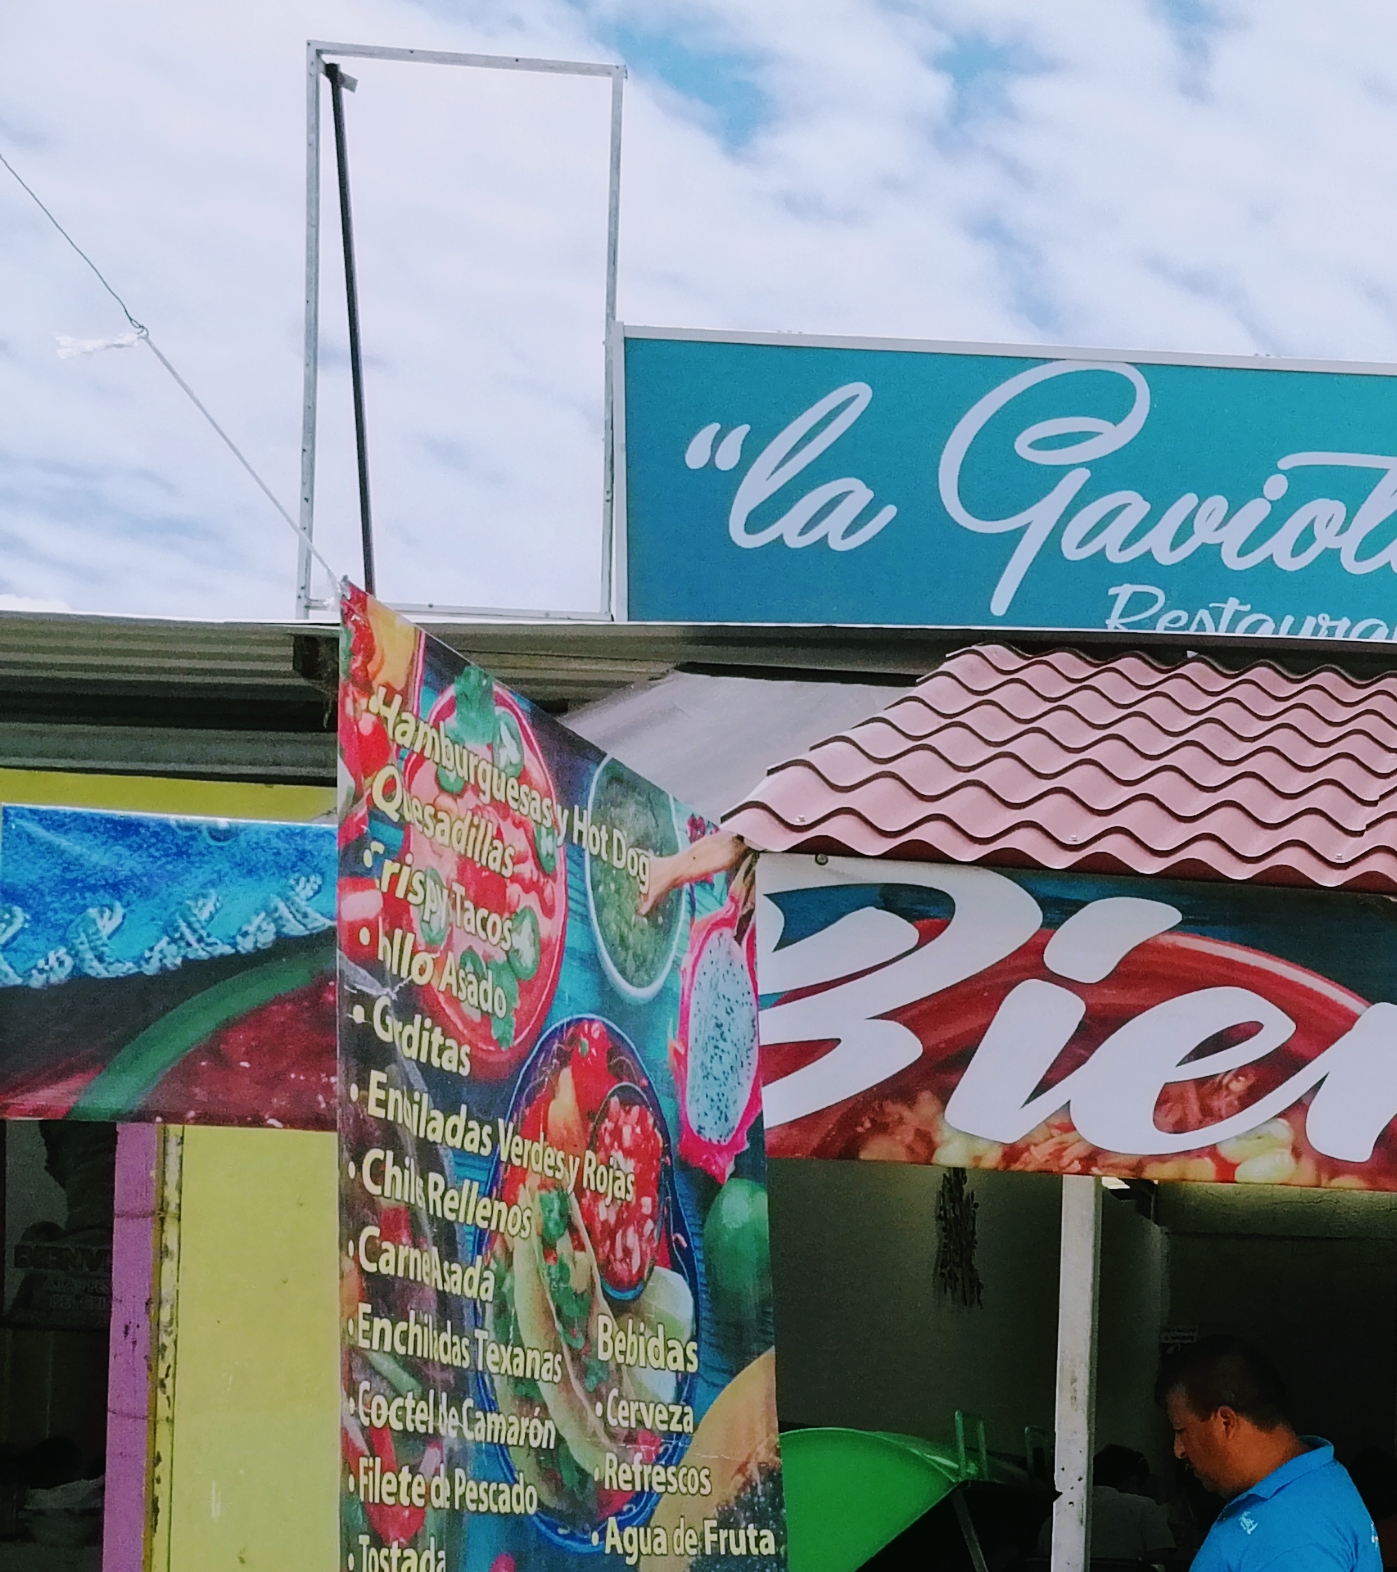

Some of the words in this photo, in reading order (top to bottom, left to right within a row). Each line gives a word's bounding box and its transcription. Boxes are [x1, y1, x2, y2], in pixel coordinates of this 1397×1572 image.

[377, 686, 552, 828] Hamburguesas
[557, 806, 569, 845] y
[573, 805, 607, 855] Hot
[613, 830, 650, 892] Dog
[451, 881, 512, 951] Tacos
[439, 950, 507, 1018] Asado
[373, 995, 470, 1077] Grditas
[499, 1119, 565, 1183] Verdes
[566, 1154, 580, 1191] y
[583, 1150, 635, 1206] Rojas
[428, 1172, 533, 1238] Rellenos
[358, 1226, 430, 1286] Carne
[430, 1246, 495, 1302] Asada
[475, 1329, 562, 1384] Texanas
[597, 1314, 698, 1373] Bebidas
[358, 1381, 434, 1435] Coctel
[462, 1398, 556, 1450] Camarón
[606, 1388, 694, 1433] Cerveza
[359, 1456, 426, 1508] Filete
[454, 1469, 538, 1515] Pescado
[604, 1452, 712, 1496] Refrescos
[605, 1517, 667, 1565] Agua
[673, 1517, 699, 1555] de
[704, 1519, 776, 1556] Fruta
